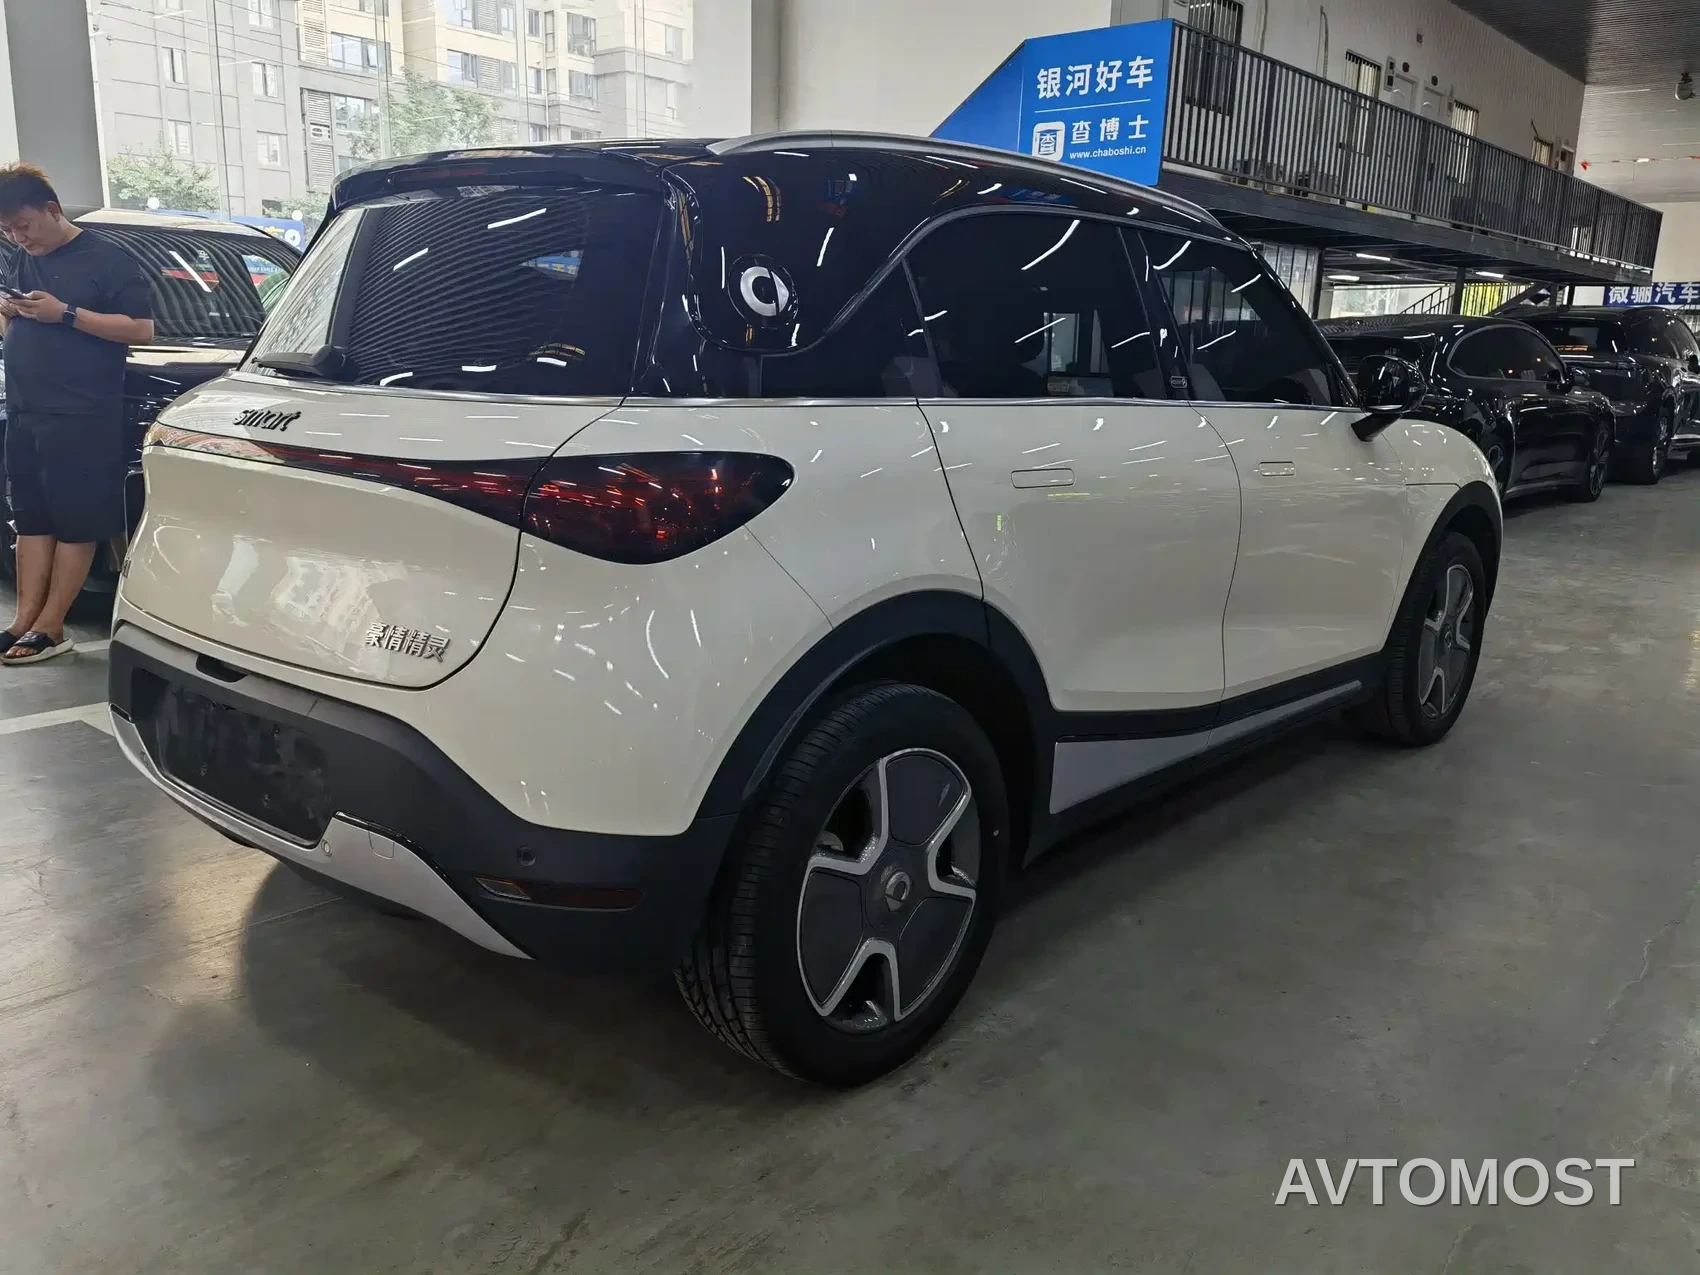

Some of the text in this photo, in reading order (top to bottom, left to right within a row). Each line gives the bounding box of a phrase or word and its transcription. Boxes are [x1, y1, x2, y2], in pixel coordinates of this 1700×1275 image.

[1037, 56, 1154, 99] 银河好车
[1070, 115, 1149, 144] 查博士
[1069, 146, 1147, 159] www.chaboshi.cn
[232, 409, 302, 432] smart
[365, 622, 450, 663] 豪情精灵
